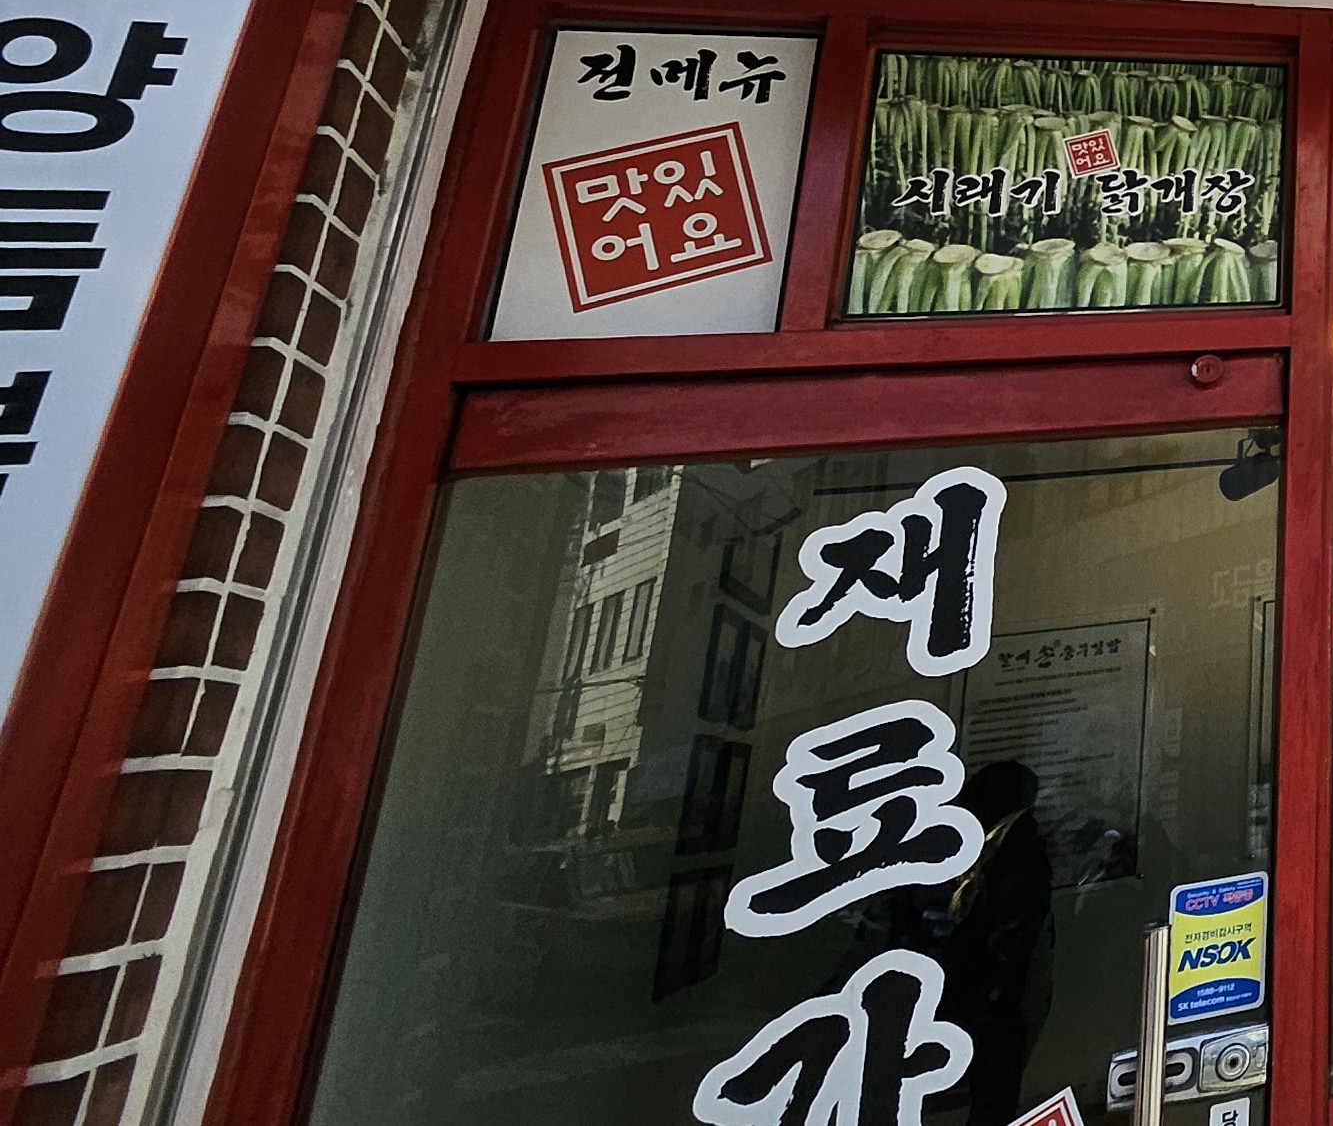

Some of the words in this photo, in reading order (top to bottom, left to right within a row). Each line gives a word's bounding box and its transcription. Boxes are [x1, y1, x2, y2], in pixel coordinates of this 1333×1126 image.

[575, 151, 719, 222] 맛있
[893, 169, 1061, 216] 시래기
[1096, 169, 1254, 216] 닭개장
[591, 211, 742, 271] 어요
[1185, 894, 1220, 912] CCTV
[1177, 937, 1256, 973] NSOK
